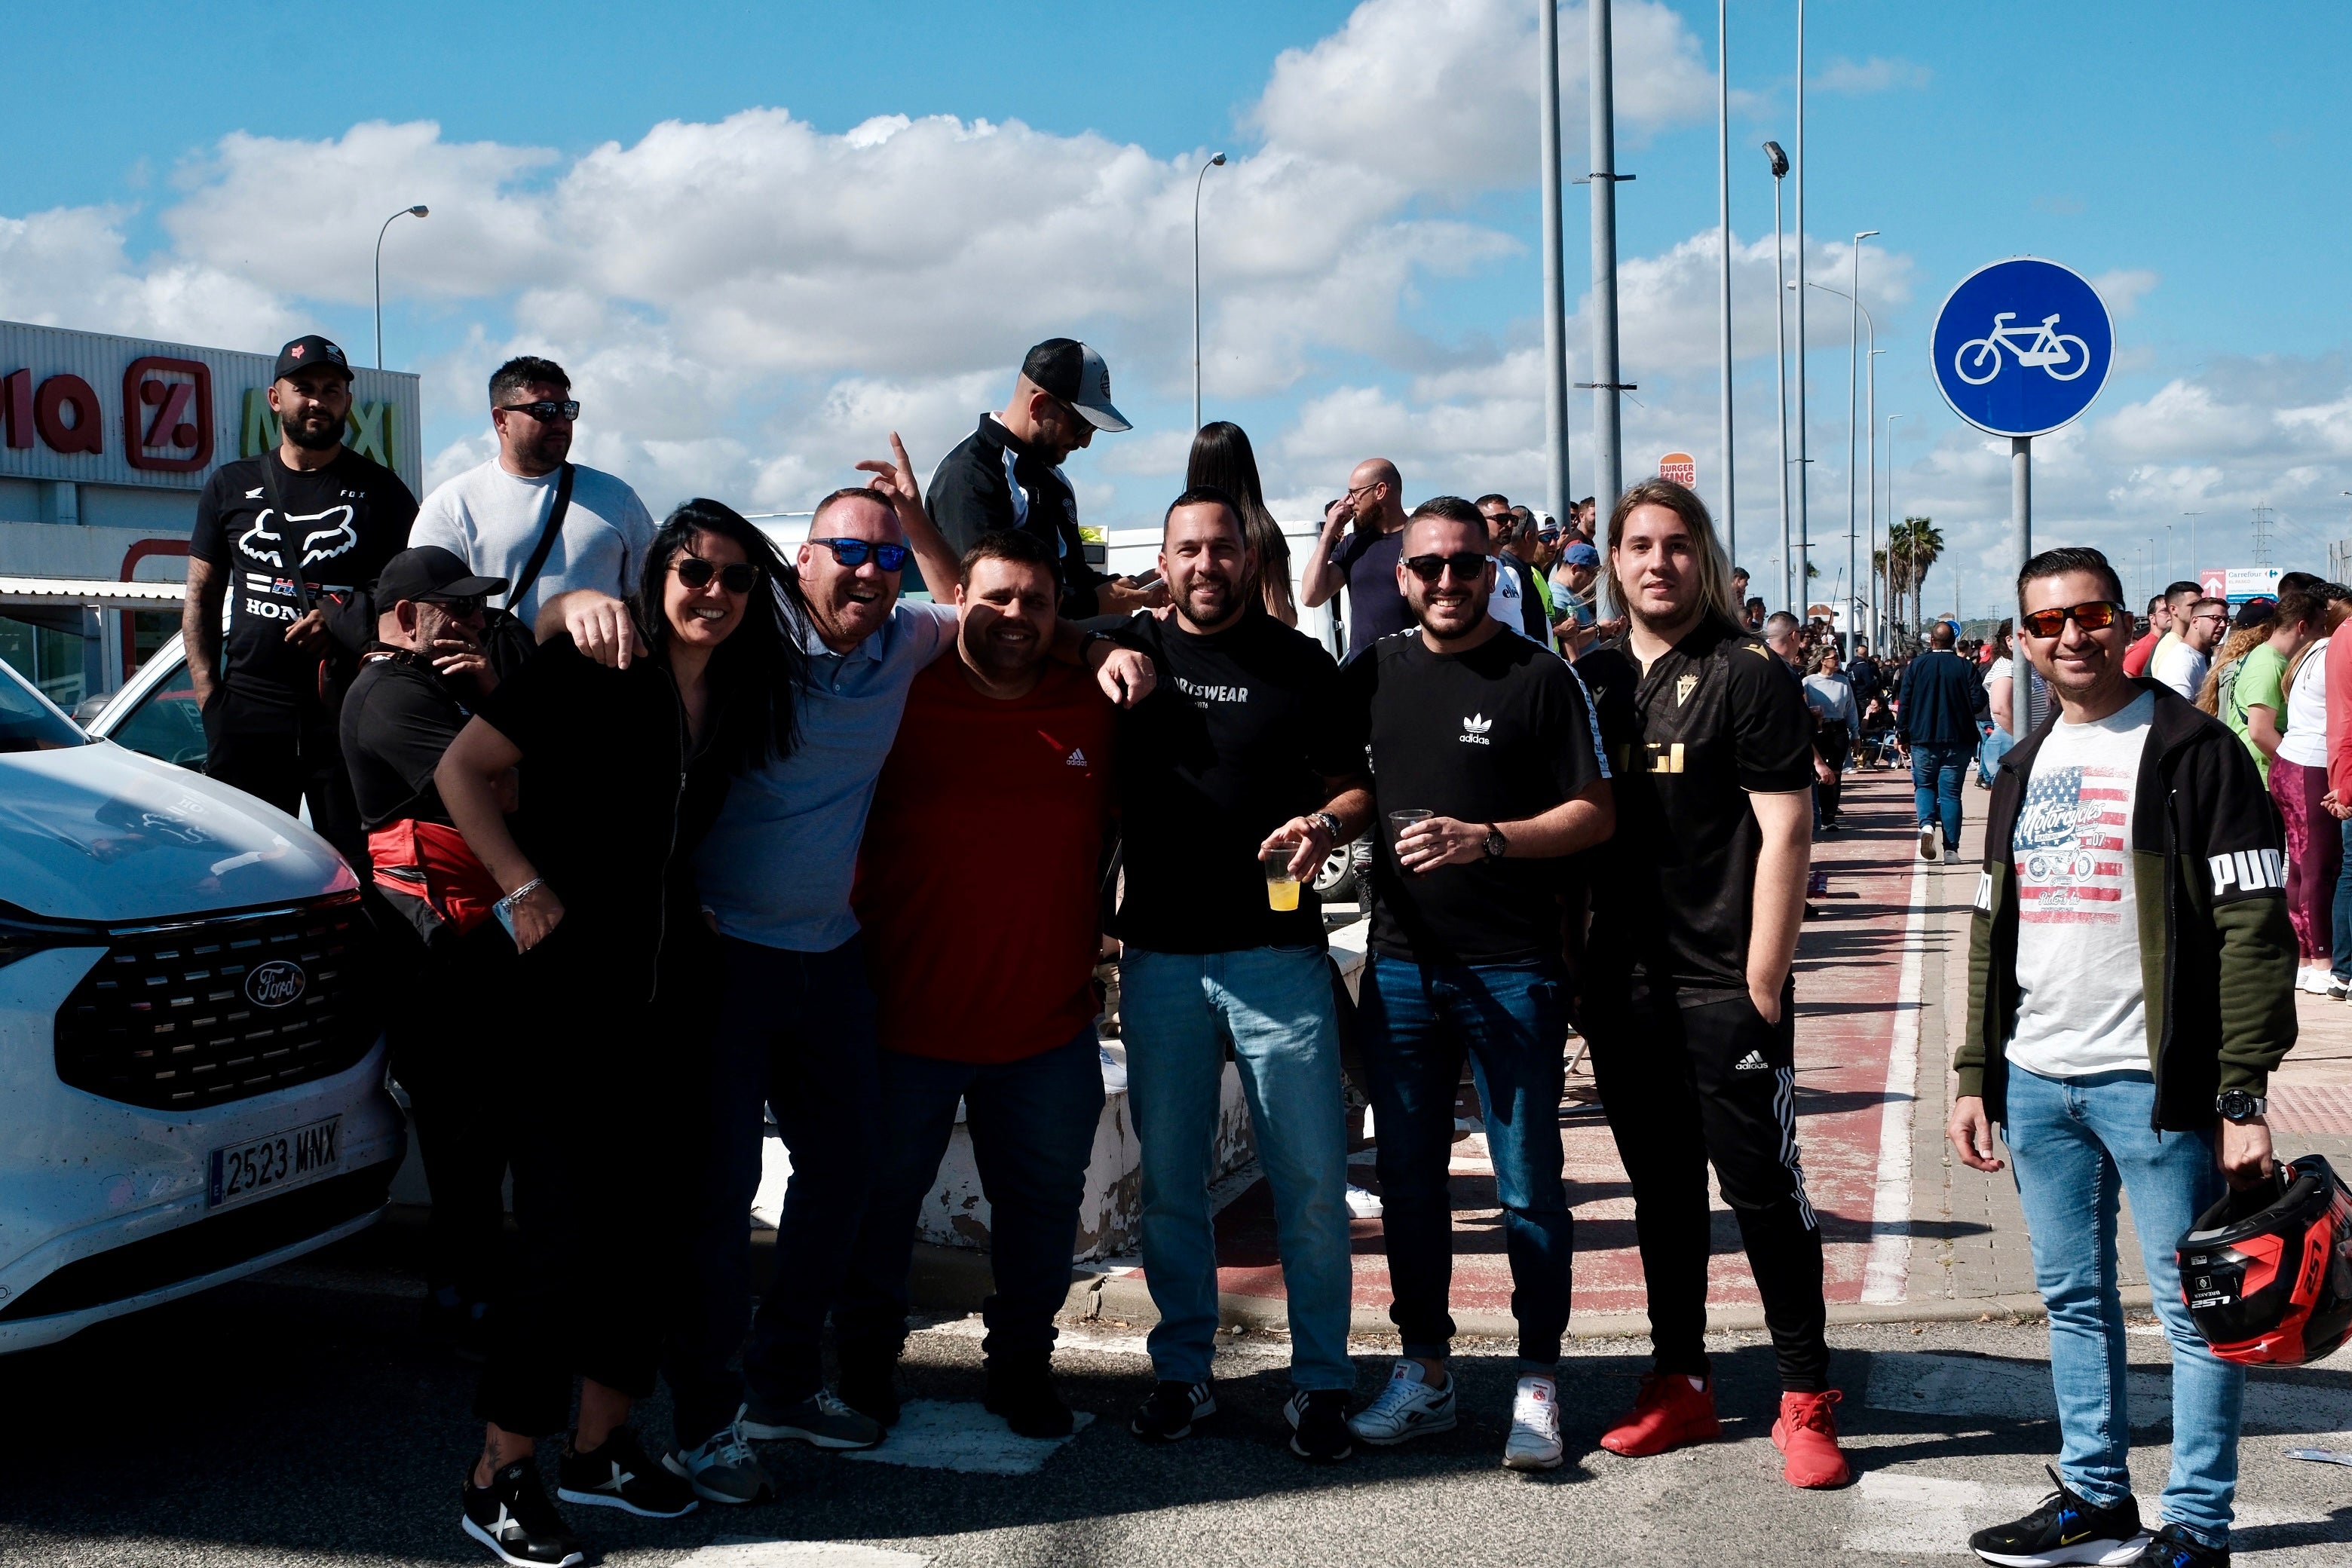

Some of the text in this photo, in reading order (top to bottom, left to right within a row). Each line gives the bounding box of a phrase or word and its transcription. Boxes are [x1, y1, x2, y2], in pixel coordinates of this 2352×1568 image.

[1661, 473, 1693, 482] KING
[340, 490, 366, 498] FOX
[247, 597, 303, 621] HON
[1459, 733, 1490, 745] adidas
[2019, 798, 2105, 841] Motorcycles
[2207, 848, 2284, 896] PUM
[258, 967, 296, 1001] Ford
[1735, 1061, 1769, 1070] adidas
[226, 1138, 286, 1196] 2523
[296, 1122, 337, 1174] MNX
[2304, 1239, 2323, 1297] LS2
[2191, 1295, 2231, 1309] LS2
[2194, 1290, 2221, 1299] BREAKER
